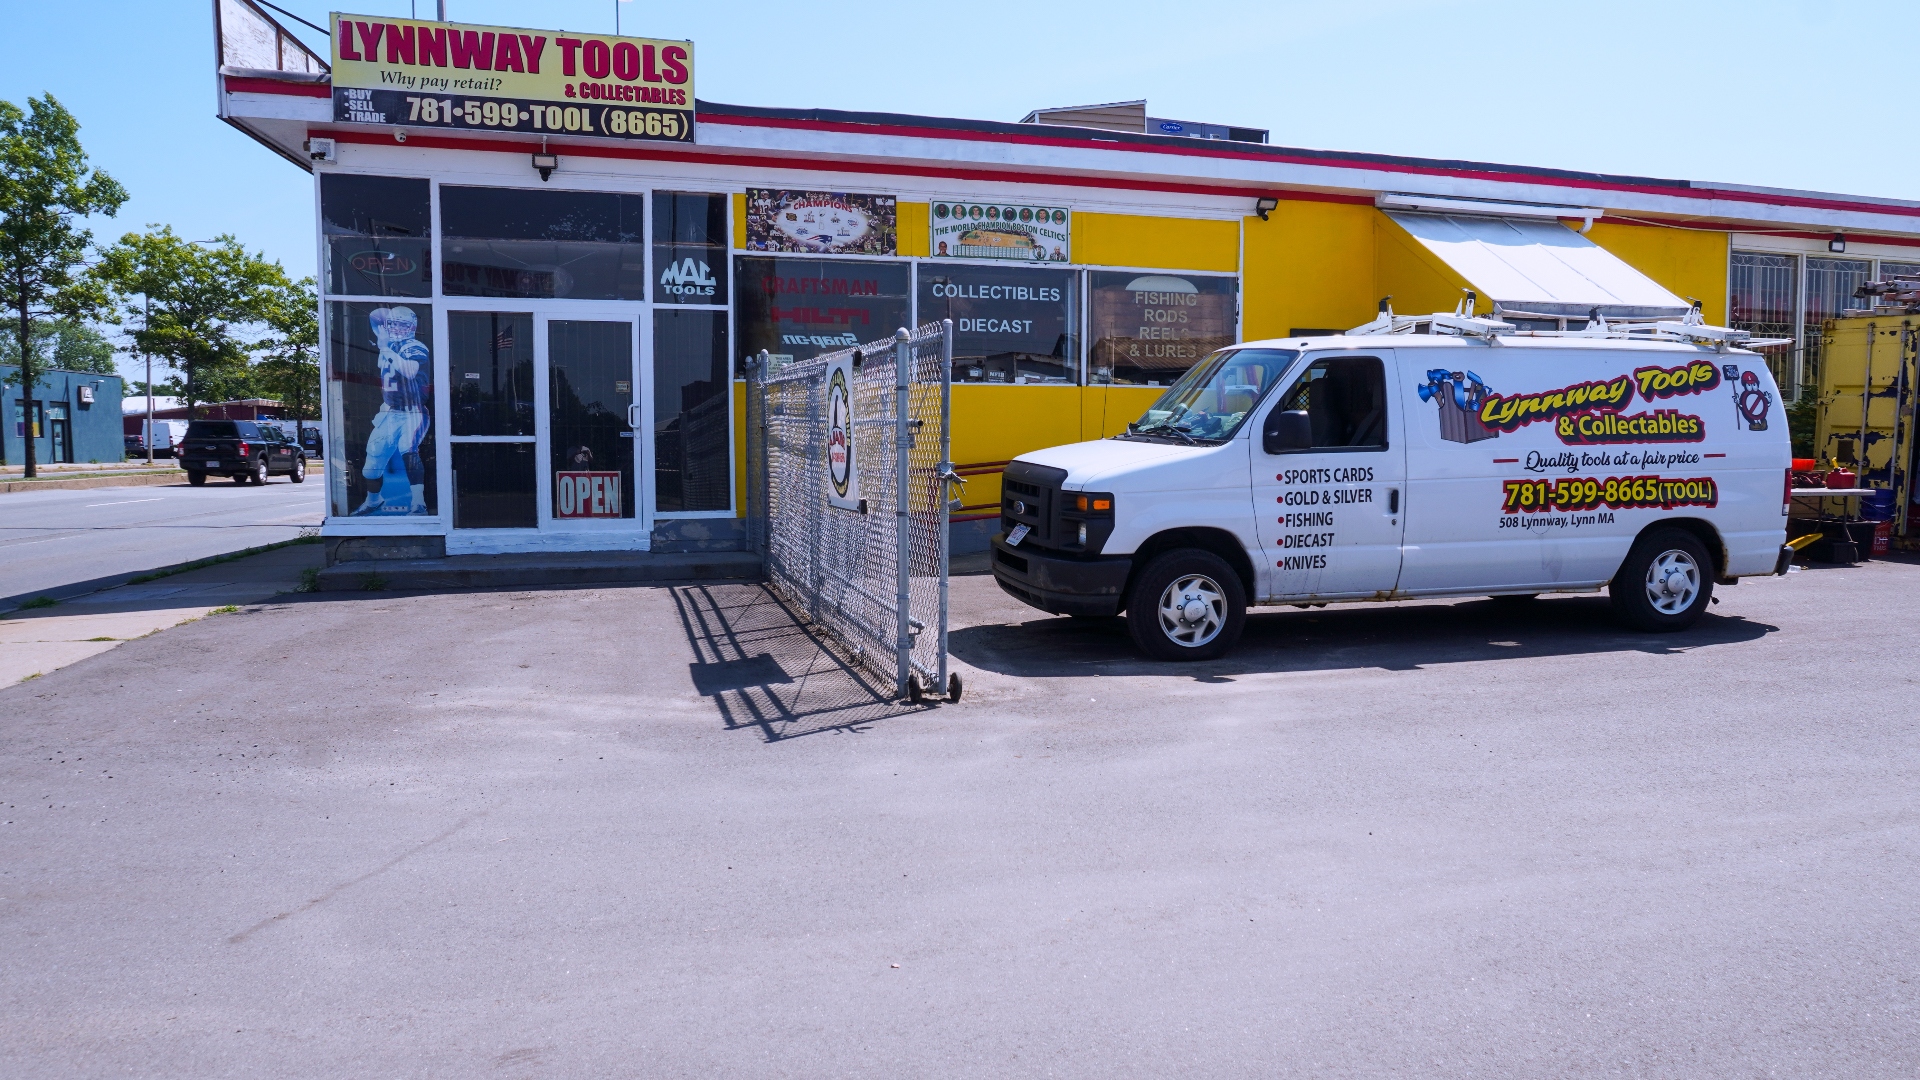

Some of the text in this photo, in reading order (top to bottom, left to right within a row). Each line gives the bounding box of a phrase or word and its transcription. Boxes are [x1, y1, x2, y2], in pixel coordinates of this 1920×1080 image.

[338, 20, 689, 85] LYNNWAY TOOLS
[380, 71, 503, 91] Why pay retail?
[565, 82, 687, 105] & COLLECTABLES
[600, 107, 689, 140] (8665)
[1162, 123, 1181, 131] Carrier
[793, 200, 853, 213] CHAMPIONS
[935, 221, 1066, 242] THE WORLD CHAMPION BOSTON CELTICS
[352, 257, 409, 271] OPEN
[660, 257, 717, 286] MAC
[663, 285, 715, 296] TOOLS
[761, 276, 878, 296] CRAFTSMAN
[932, 283, 1061, 302] COLLECTIBLES
[1135, 291, 1197, 307] FISHING
[771, 306, 870, 325] HILTI
[1144, 308, 1188, 323] RODS
[960, 318, 1033, 334] DIECAST
[1139, 326, 1189, 341] REELS
[1129, 344, 1197, 358] & LURES
[1480, 363, 1714, 424] Lynnway Tools
[1558, 413, 1698, 436] & Collectables
[1524, 450, 1700, 473] Quality tools at a fair price
[1284, 467, 1374, 484] SPORTS CARDS
[560, 475, 619, 516] OPEN
[1284, 488, 1372, 506] GOLD & SILVER
[1285, 511, 1333, 528] FISHING
[1499, 512, 1615, 531] 508 Lynnway, Lynn MA
[1284, 533, 1335, 549] DIECAST
[1283, 554, 1327, 571] KNIVES
